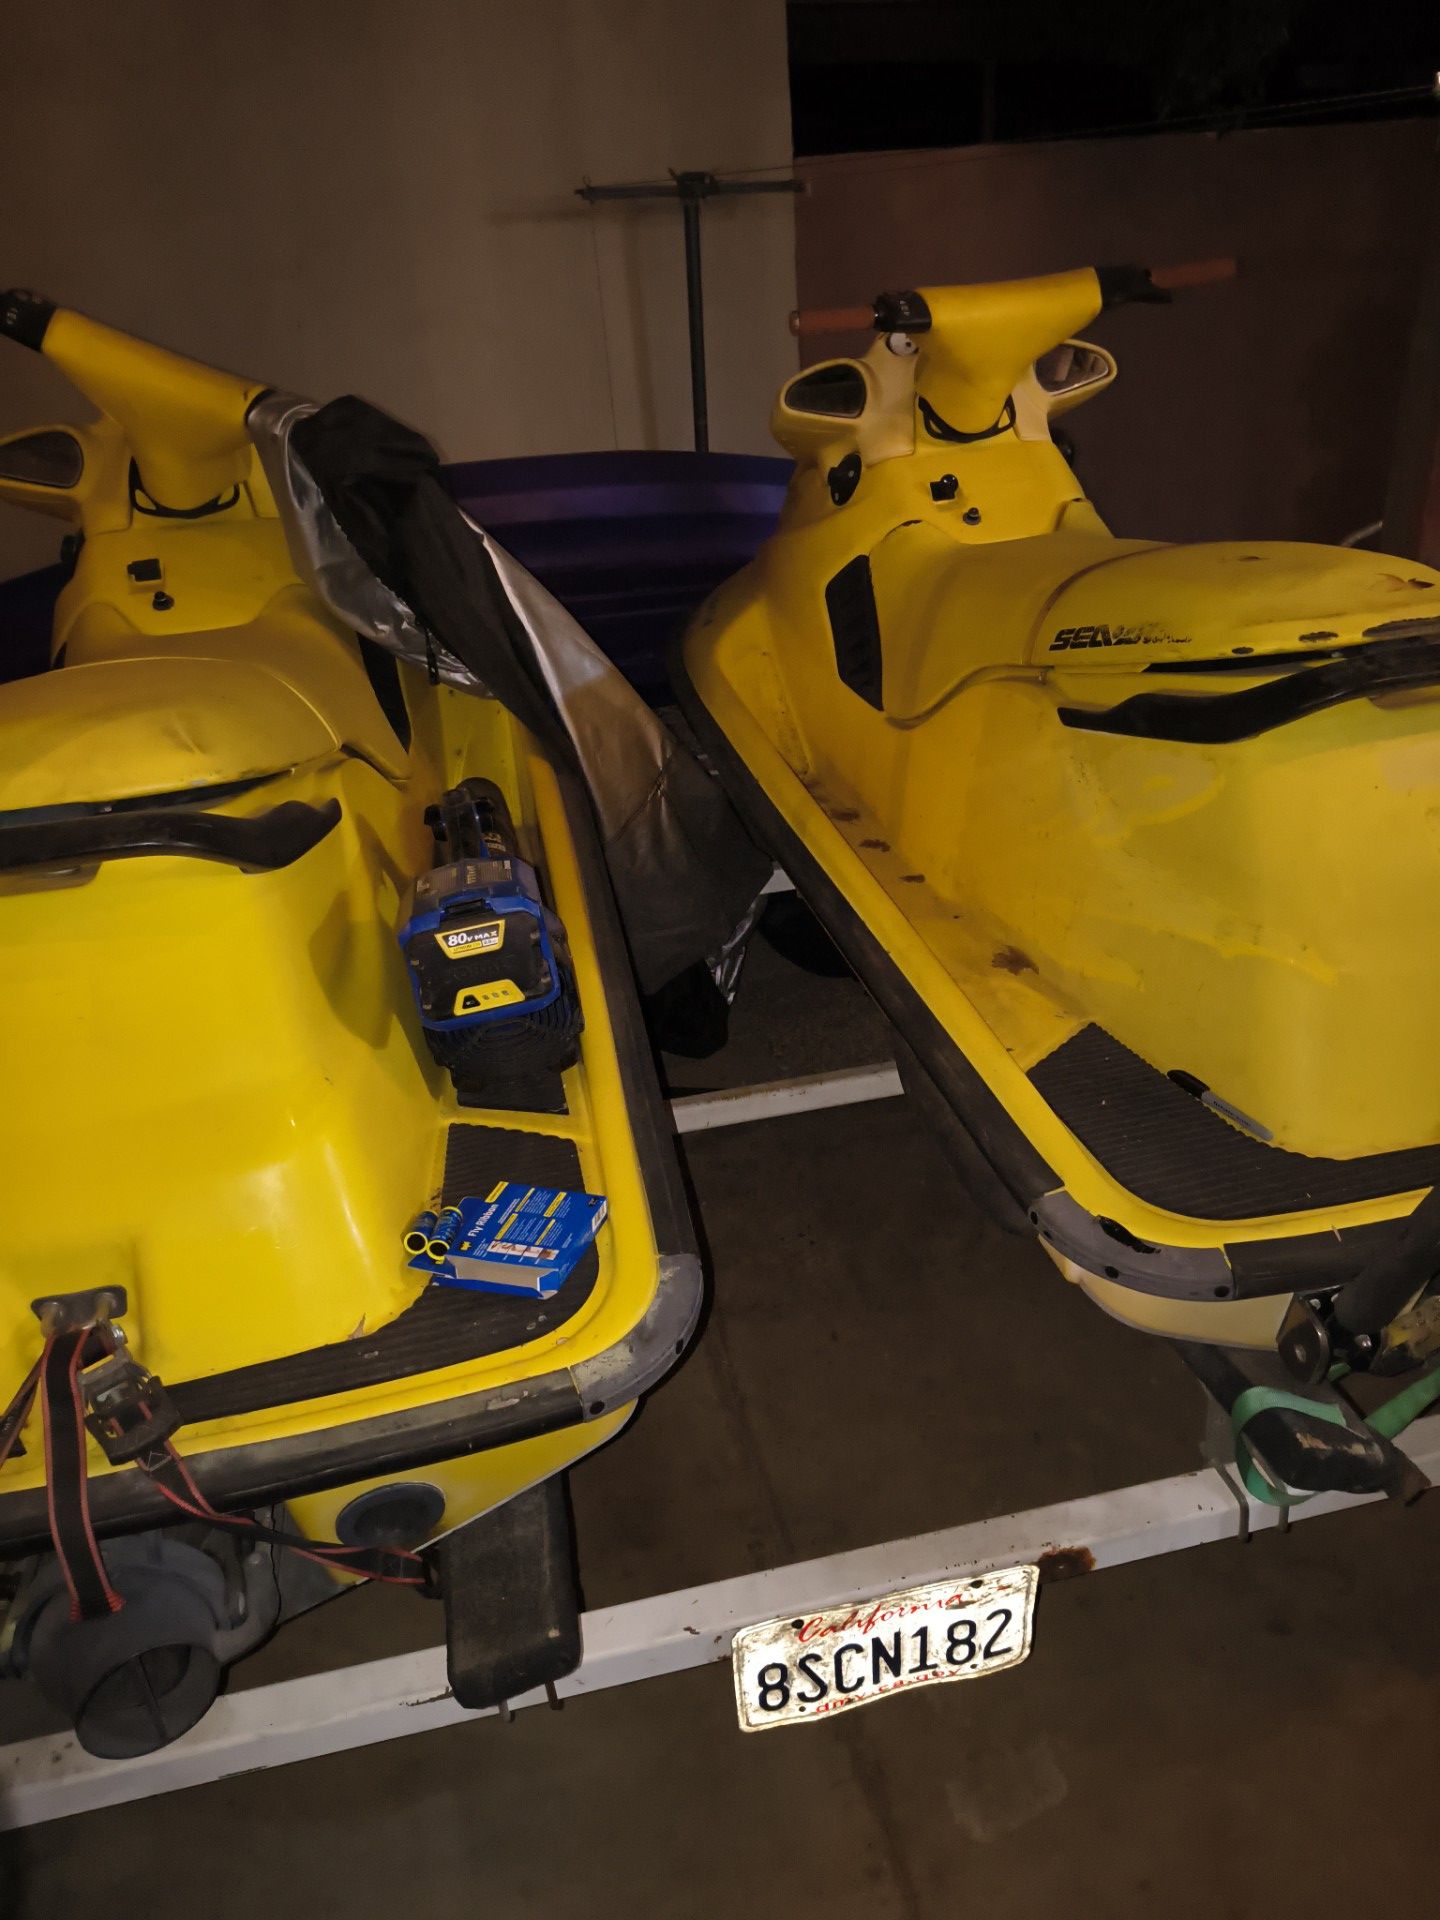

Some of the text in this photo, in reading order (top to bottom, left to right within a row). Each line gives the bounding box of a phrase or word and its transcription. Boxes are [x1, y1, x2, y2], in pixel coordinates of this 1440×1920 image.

[474, 930, 498, 940] MAX
[475, 1204, 499, 1226] Ribbon
[467, 1226, 484, 1237] Fly
[798, 1592, 965, 1643] California
[756, 1608, 1014, 1712] 8SCN182
